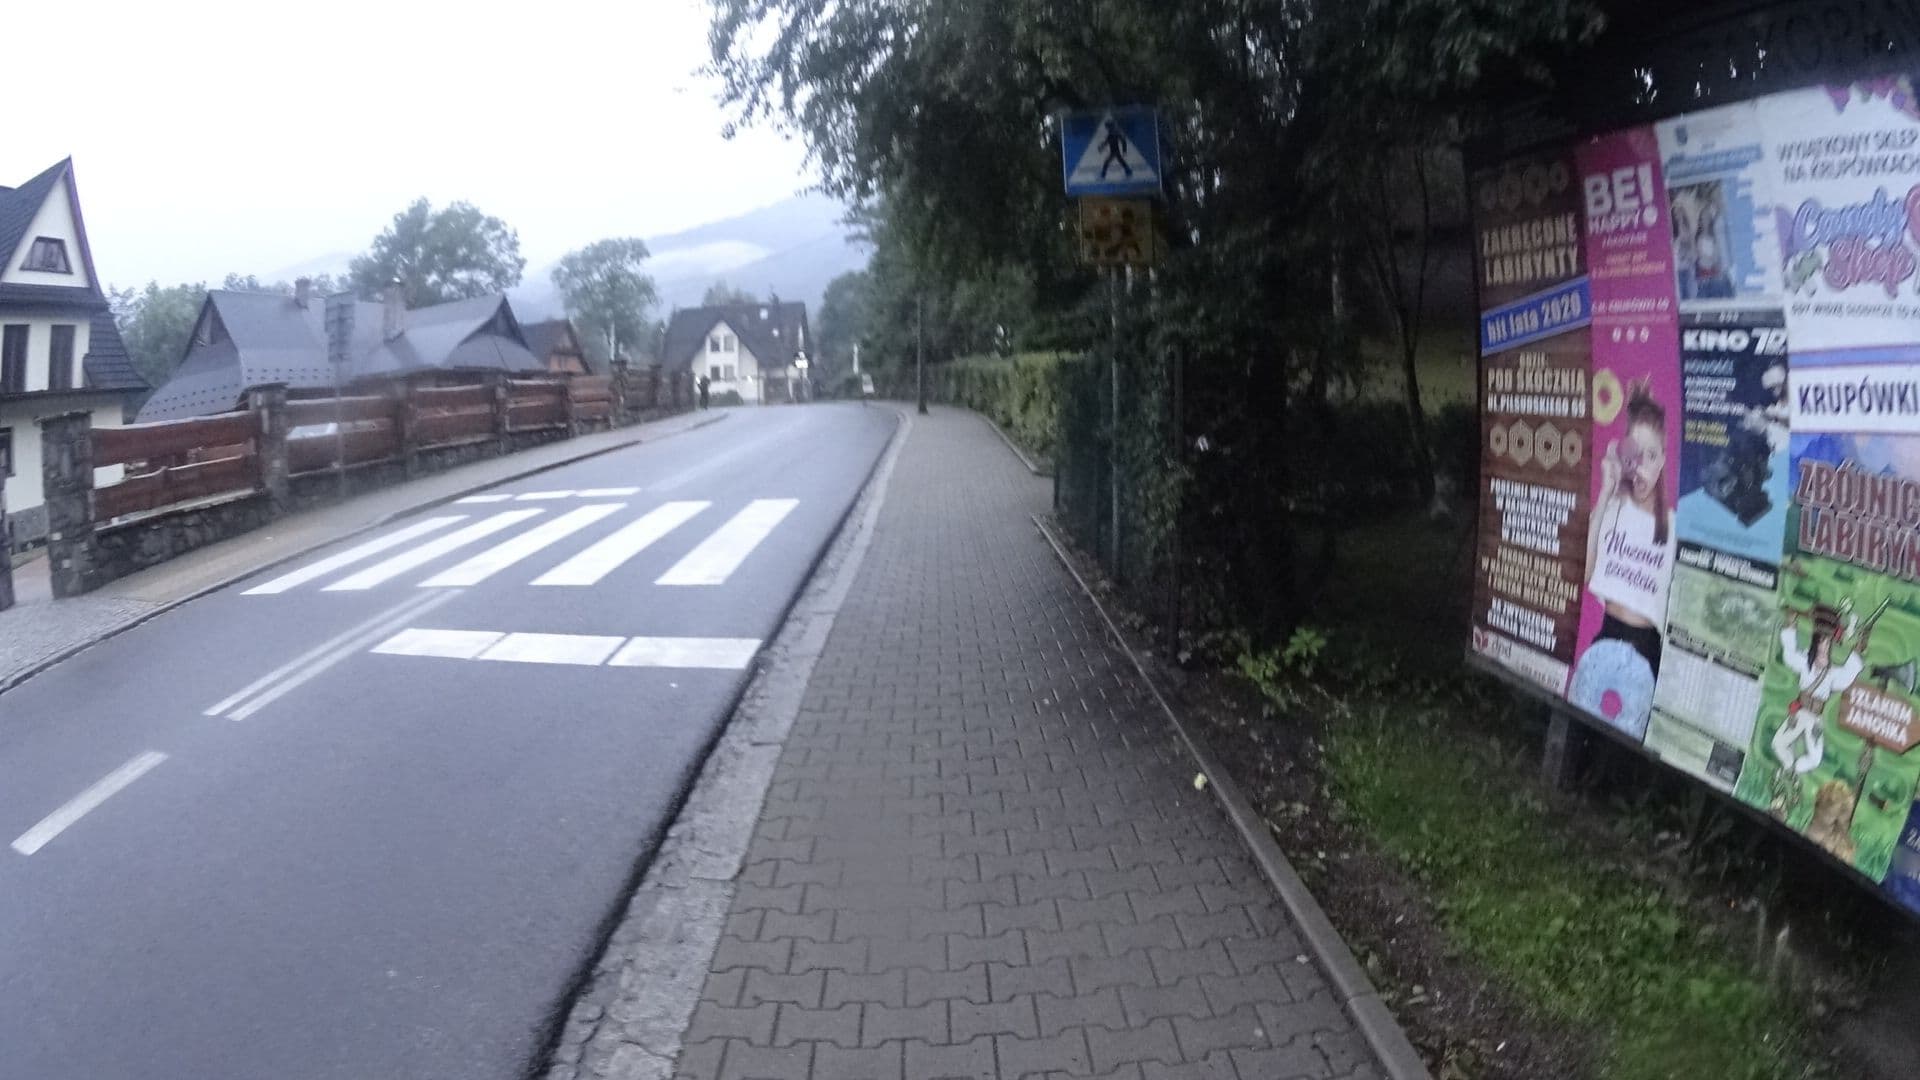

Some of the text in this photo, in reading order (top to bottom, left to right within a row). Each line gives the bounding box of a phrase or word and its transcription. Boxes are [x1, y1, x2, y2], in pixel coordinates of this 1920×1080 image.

[1584, 161, 1658, 227] BE!
[1793, 186, 1909, 256] Candy
[1485, 245, 1578, 286] LABIRYNTY
[1823, 234, 1916, 299] Shop
[1541, 290, 1582, 328] 2020
[1683, 328, 1750, 352] KINO
[1488, 367, 1513, 393] POD
[1799, 375, 1919, 417] KRUPÓWKI
